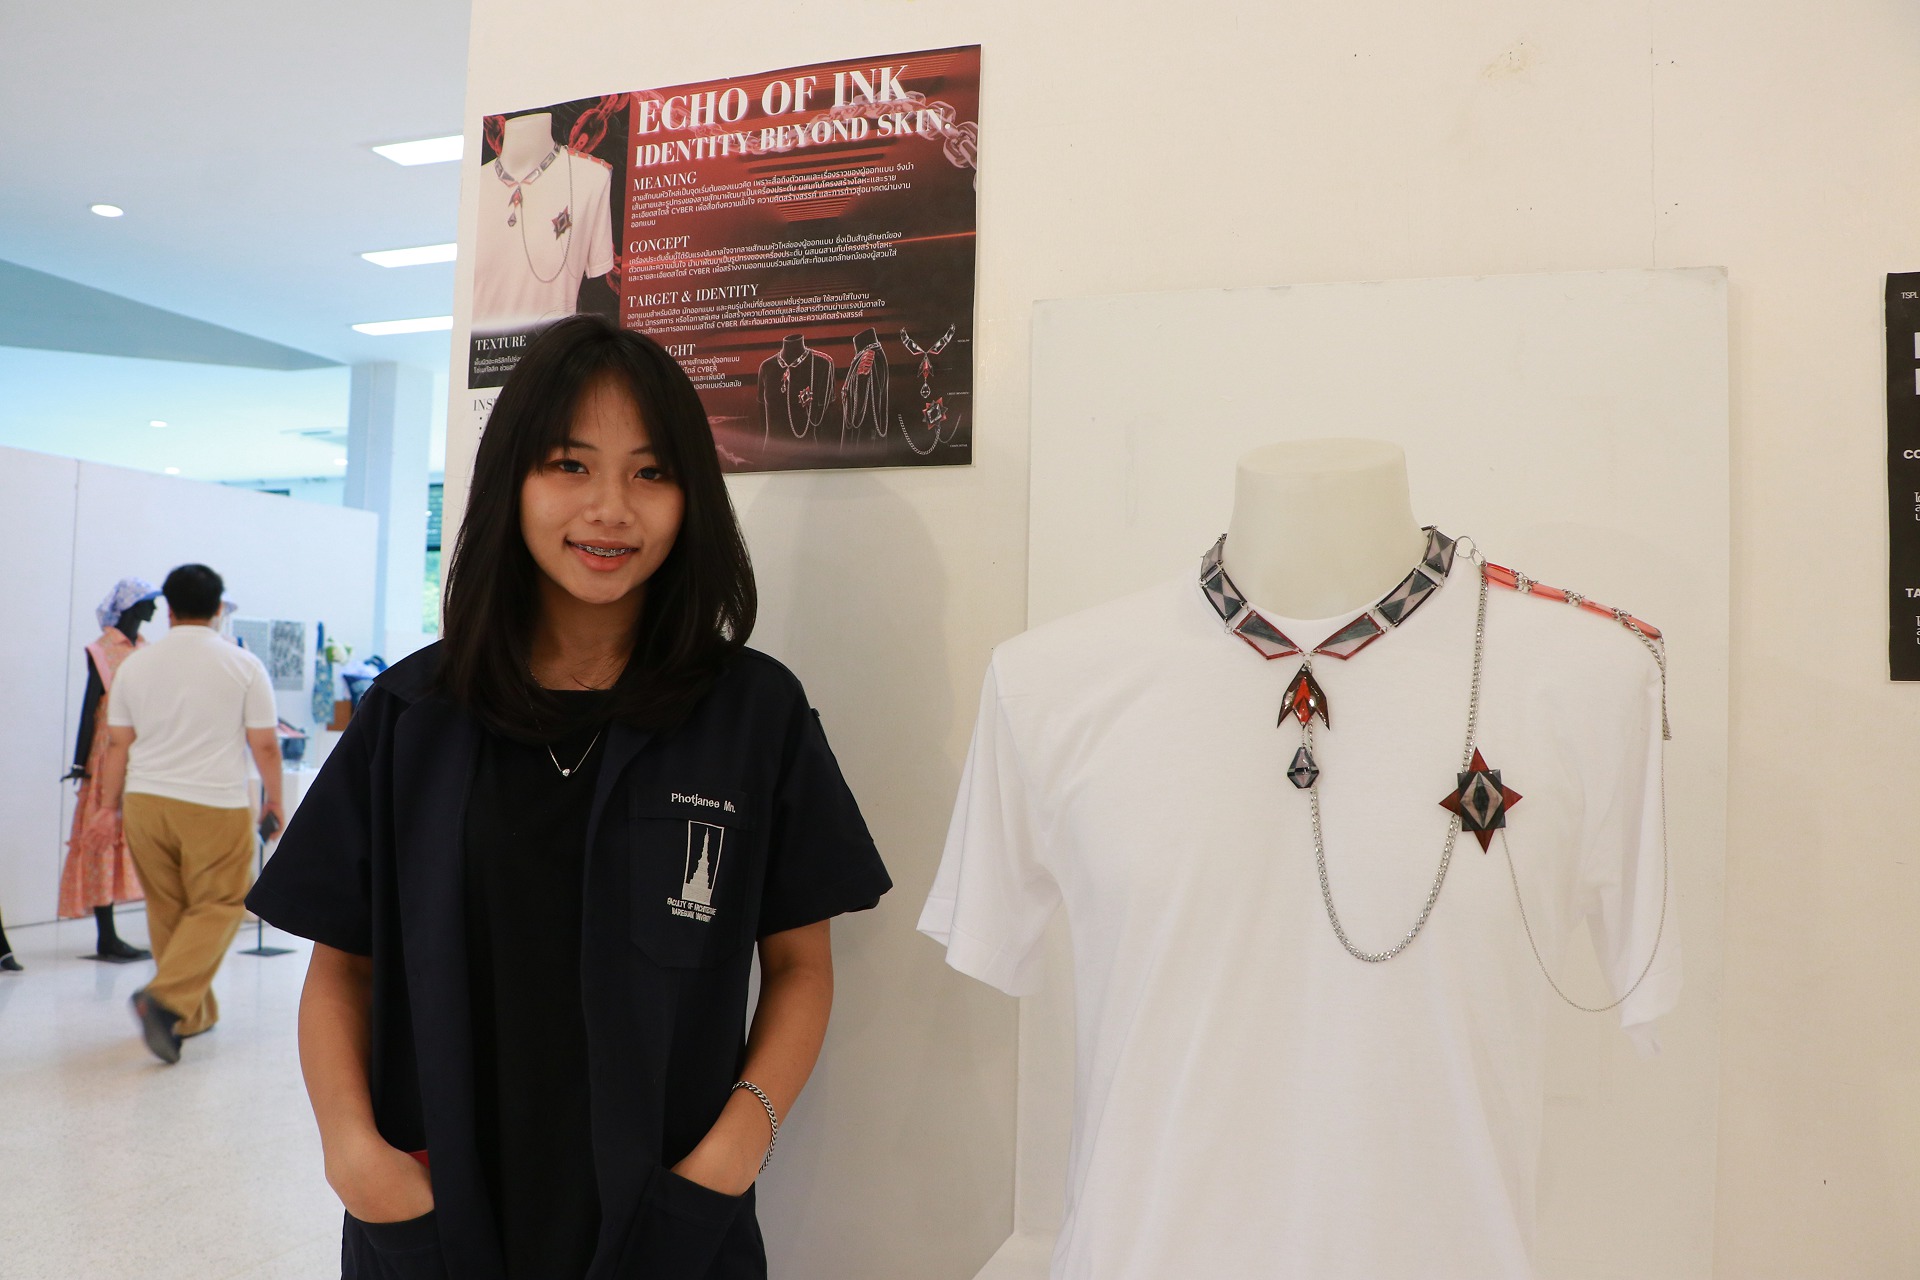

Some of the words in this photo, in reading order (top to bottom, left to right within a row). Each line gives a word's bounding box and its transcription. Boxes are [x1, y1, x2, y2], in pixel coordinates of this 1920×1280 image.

[637, 87, 748, 135] ECHO
[761, 76, 817, 116] OF
[832, 65, 908, 107] INK
[635, 130, 753, 167] IDENTITY
[760, 118, 868, 151] BEYOND
[876, 108, 952, 137] SKIN.
[633, 171, 697, 191] MEANING
[671, 205, 694, 215] CYBER
[629, 235, 690, 254] CONCEPT
[688, 267, 711, 276] CYBER
[627, 291, 679, 308] TARGET
[681, 290, 692, 303] &
[696, 284, 759, 301] IDENTITY
[716, 320, 738, 329] CYBER
[475, 336, 526, 350] TEXTURE
[697, 365, 718, 373] CYBER
[671, 792, 720, 809] Photjanee
